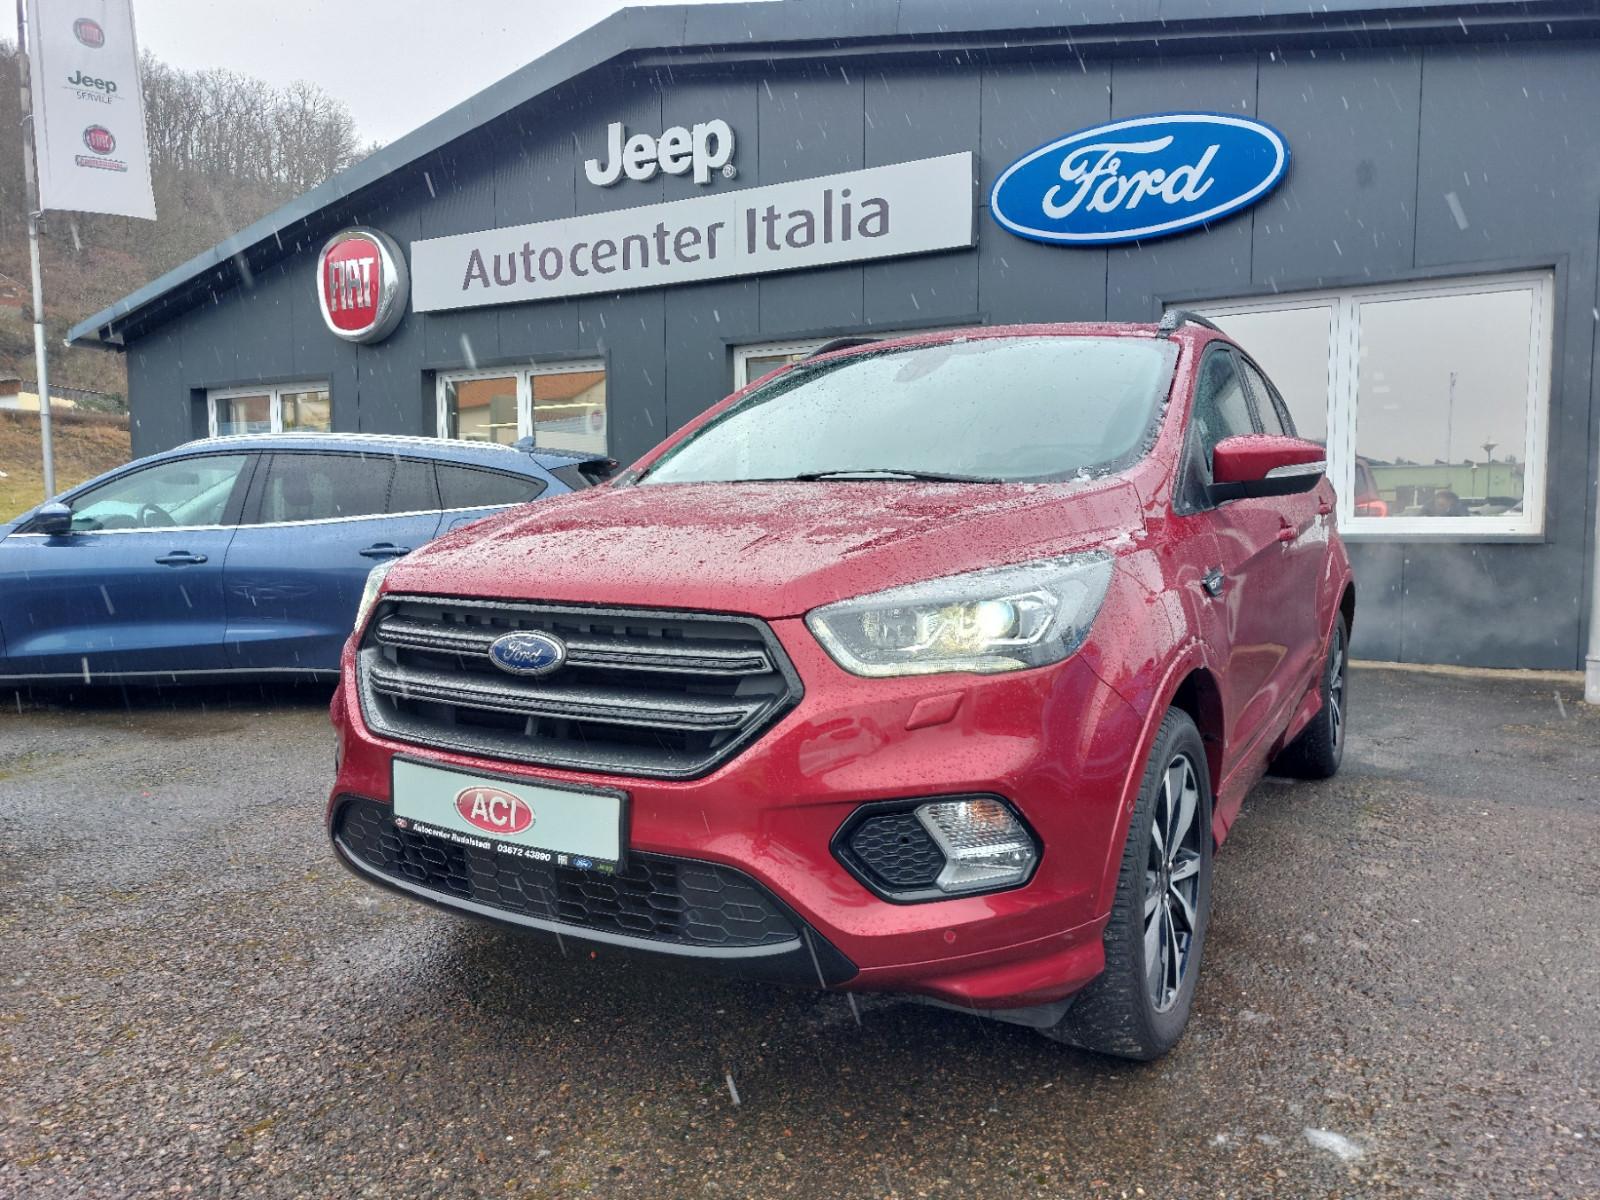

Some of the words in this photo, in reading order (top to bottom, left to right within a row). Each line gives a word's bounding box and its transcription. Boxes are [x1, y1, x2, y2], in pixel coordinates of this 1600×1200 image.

[67, 70, 118, 94] Jeep
[1041, 135, 1220, 220] Ford
[462, 222, 726, 292] Autocenter
[745, 188, 891, 254] Italia
[329, 256, 375, 312] FIAT
[503, 640, 544, 662] Ford
[470, 791, 518, 829] ACI
[412, 823, 451, 839] Autocenter
[497, 844, 523, 857] 03672
[524, 850, 552, 862] 43890
